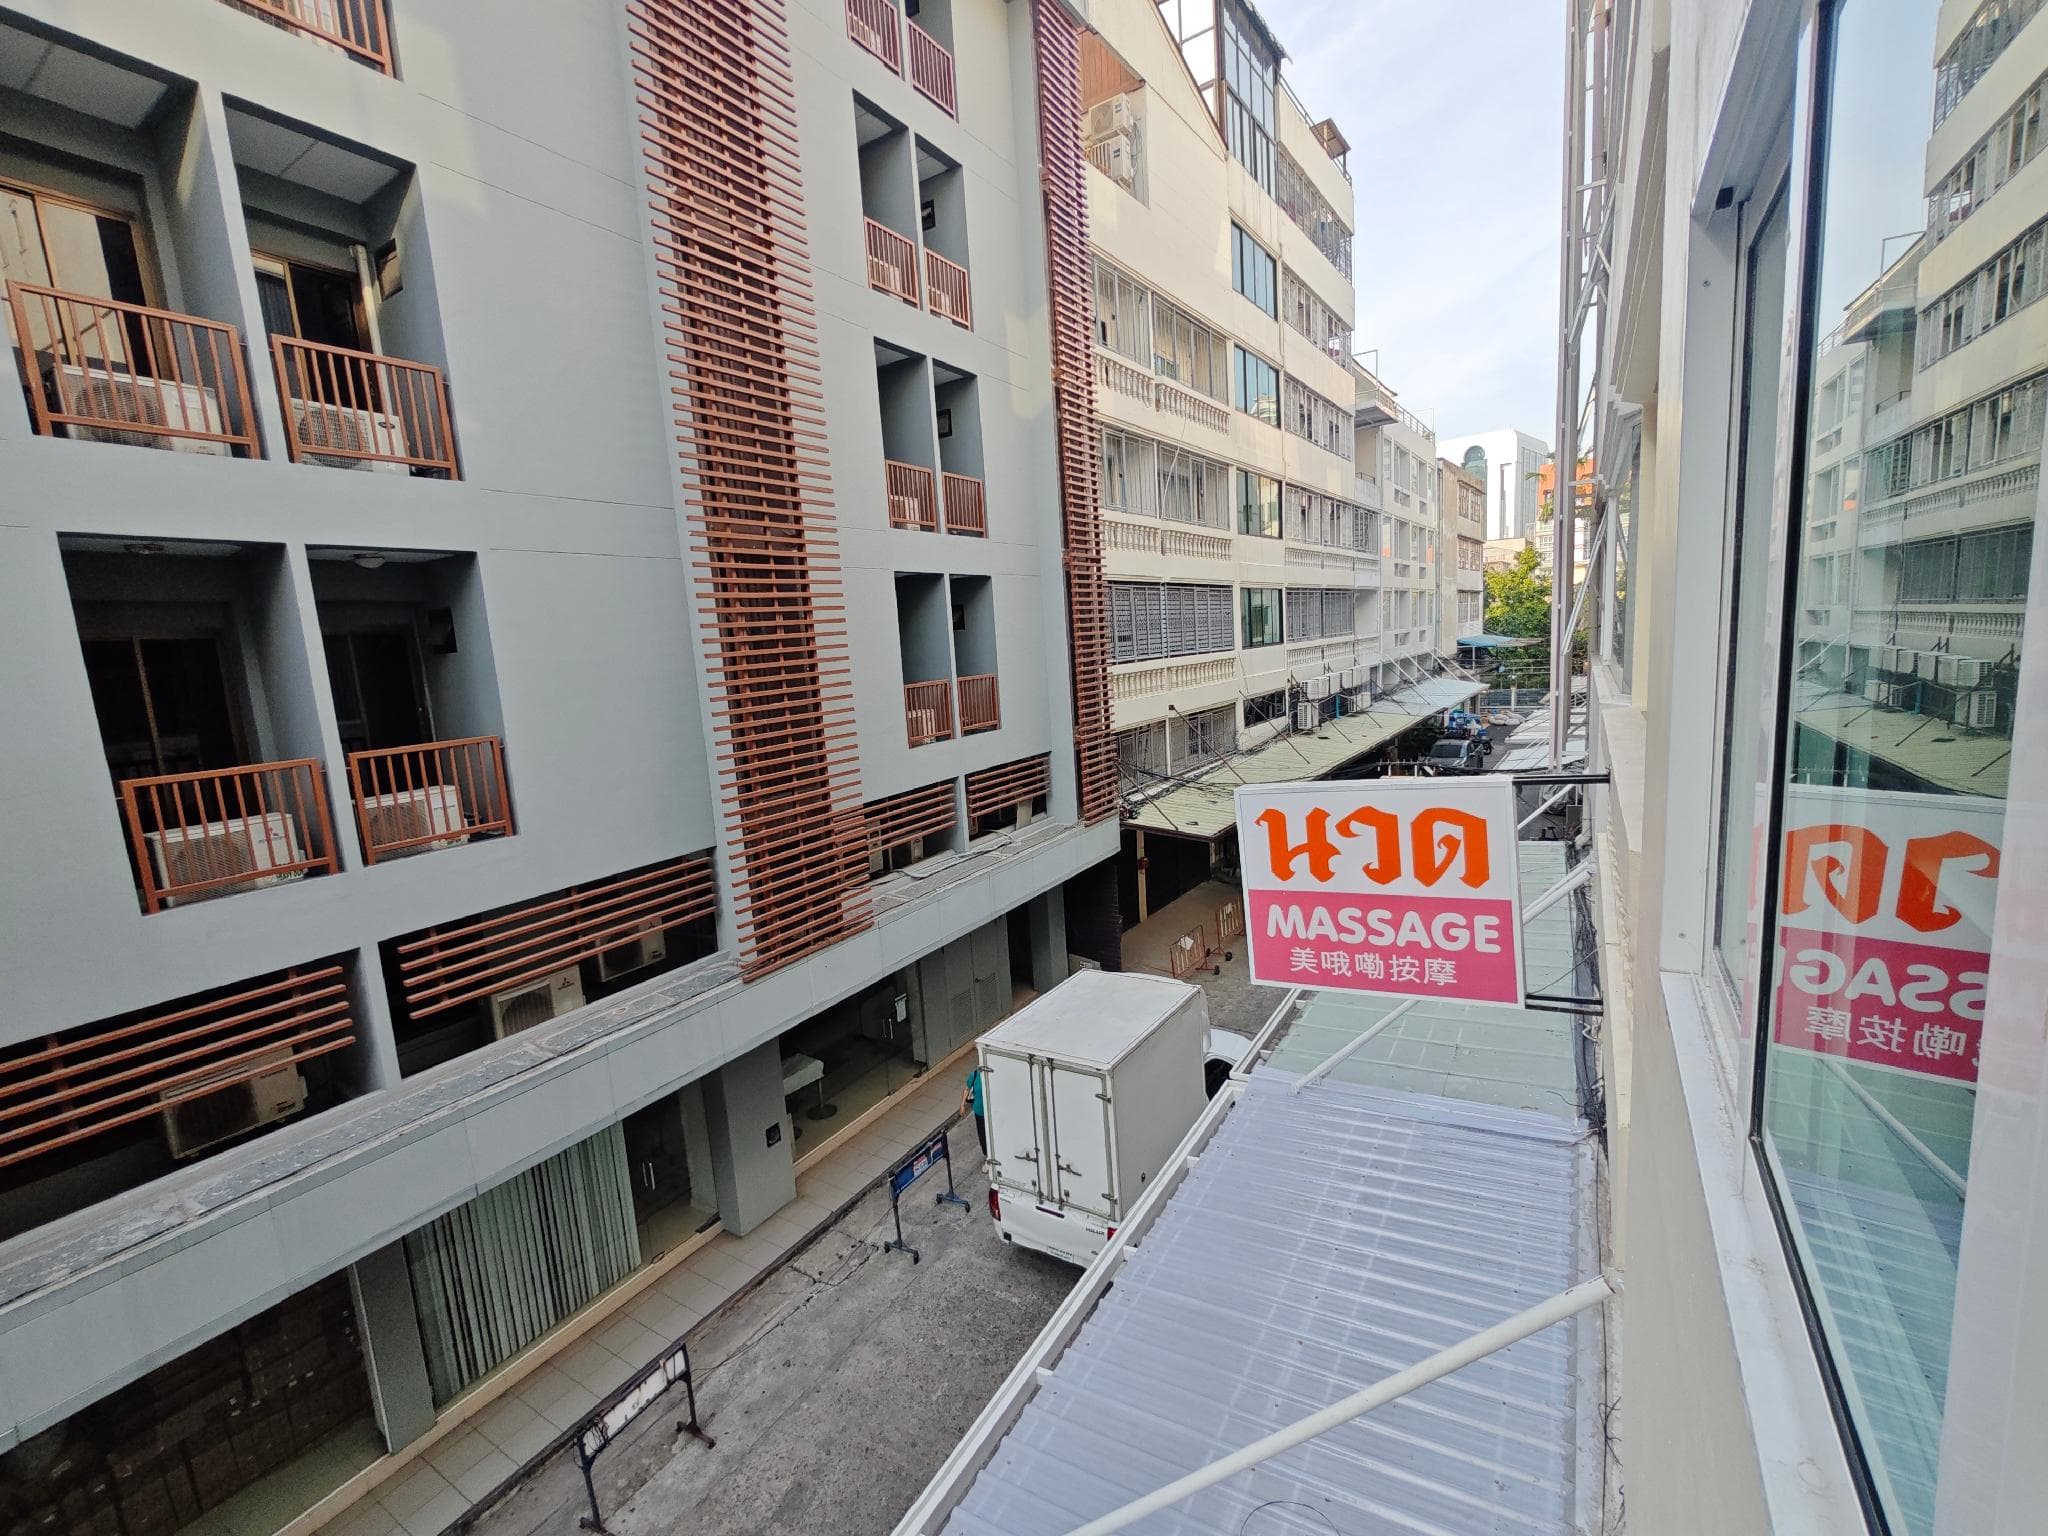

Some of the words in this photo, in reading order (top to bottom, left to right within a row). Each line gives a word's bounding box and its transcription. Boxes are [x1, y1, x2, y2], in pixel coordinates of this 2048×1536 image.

[1254, 805, 1490, 889] นวด
[1266, 904, 1501, 953] MASSAGE
[1289, 946, 1458, 986] 美哦嘞按摩
